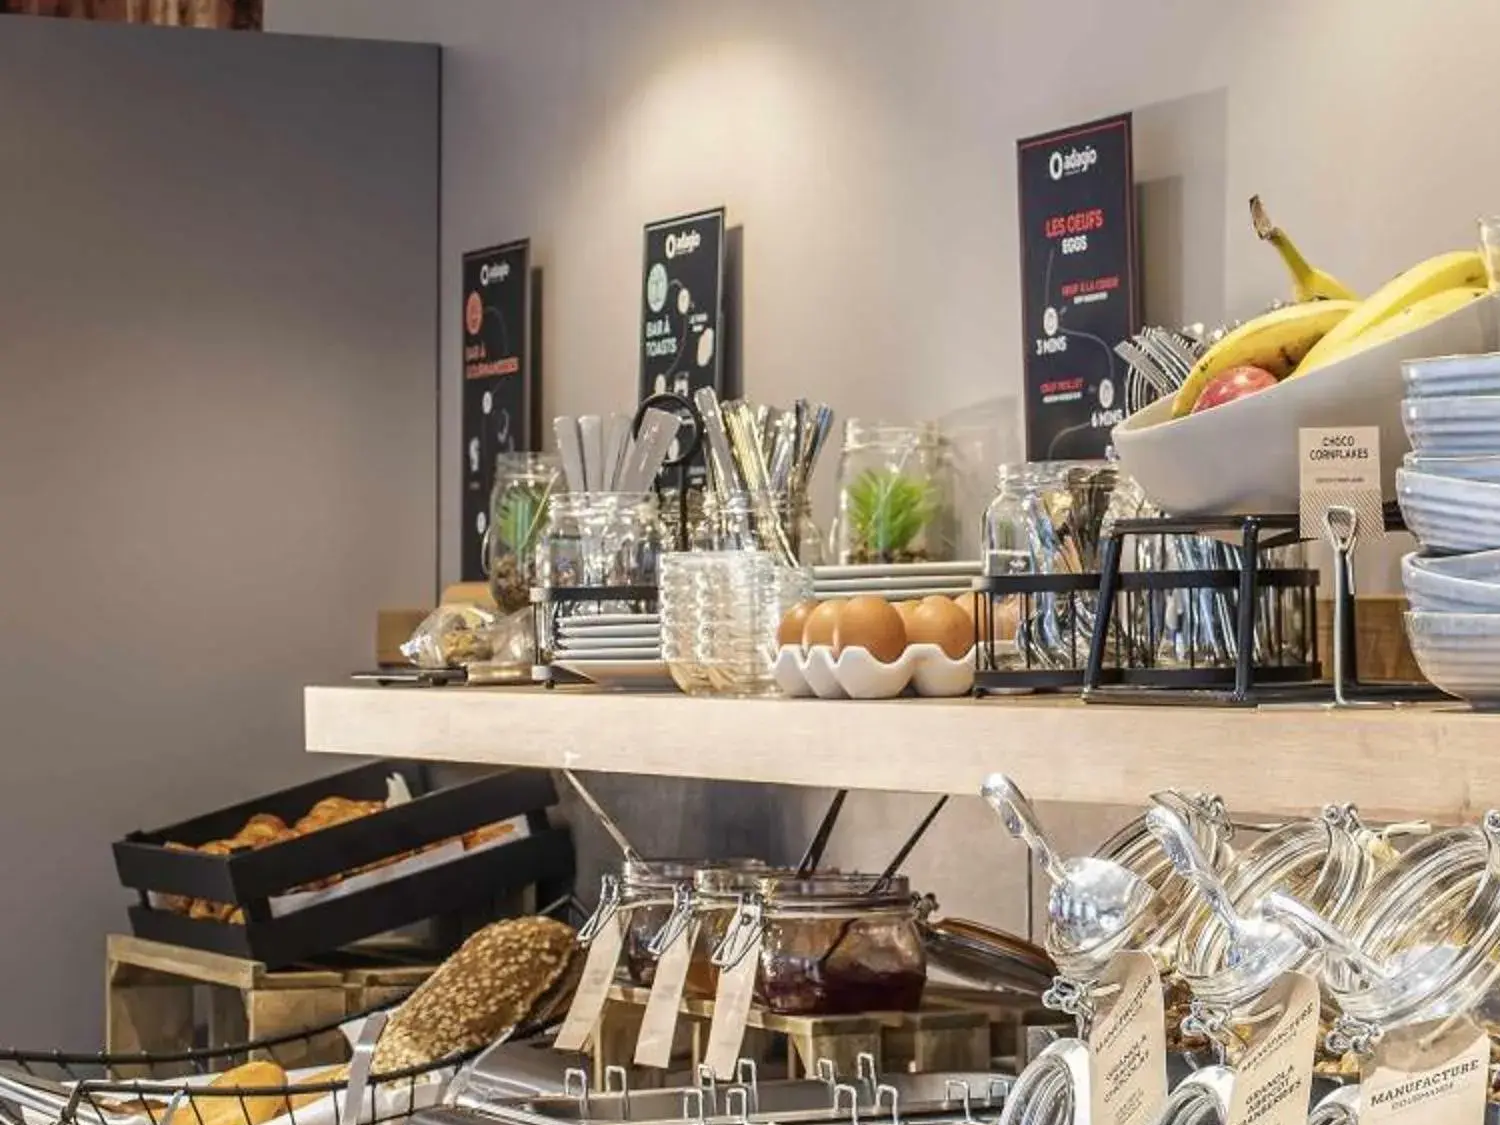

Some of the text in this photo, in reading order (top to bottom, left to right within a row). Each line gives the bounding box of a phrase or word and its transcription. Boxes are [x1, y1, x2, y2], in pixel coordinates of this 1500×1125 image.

[1045, 217, 1066, 238] LES
[1322, 435, 1355, 447] CHOCO
[1309, 448, 1368, 461] CORNFLAKES
[1246, 1065, 1294, 1105] GRANOLA
[1371, 1059, 1479, 1107] MANUFACTURE
